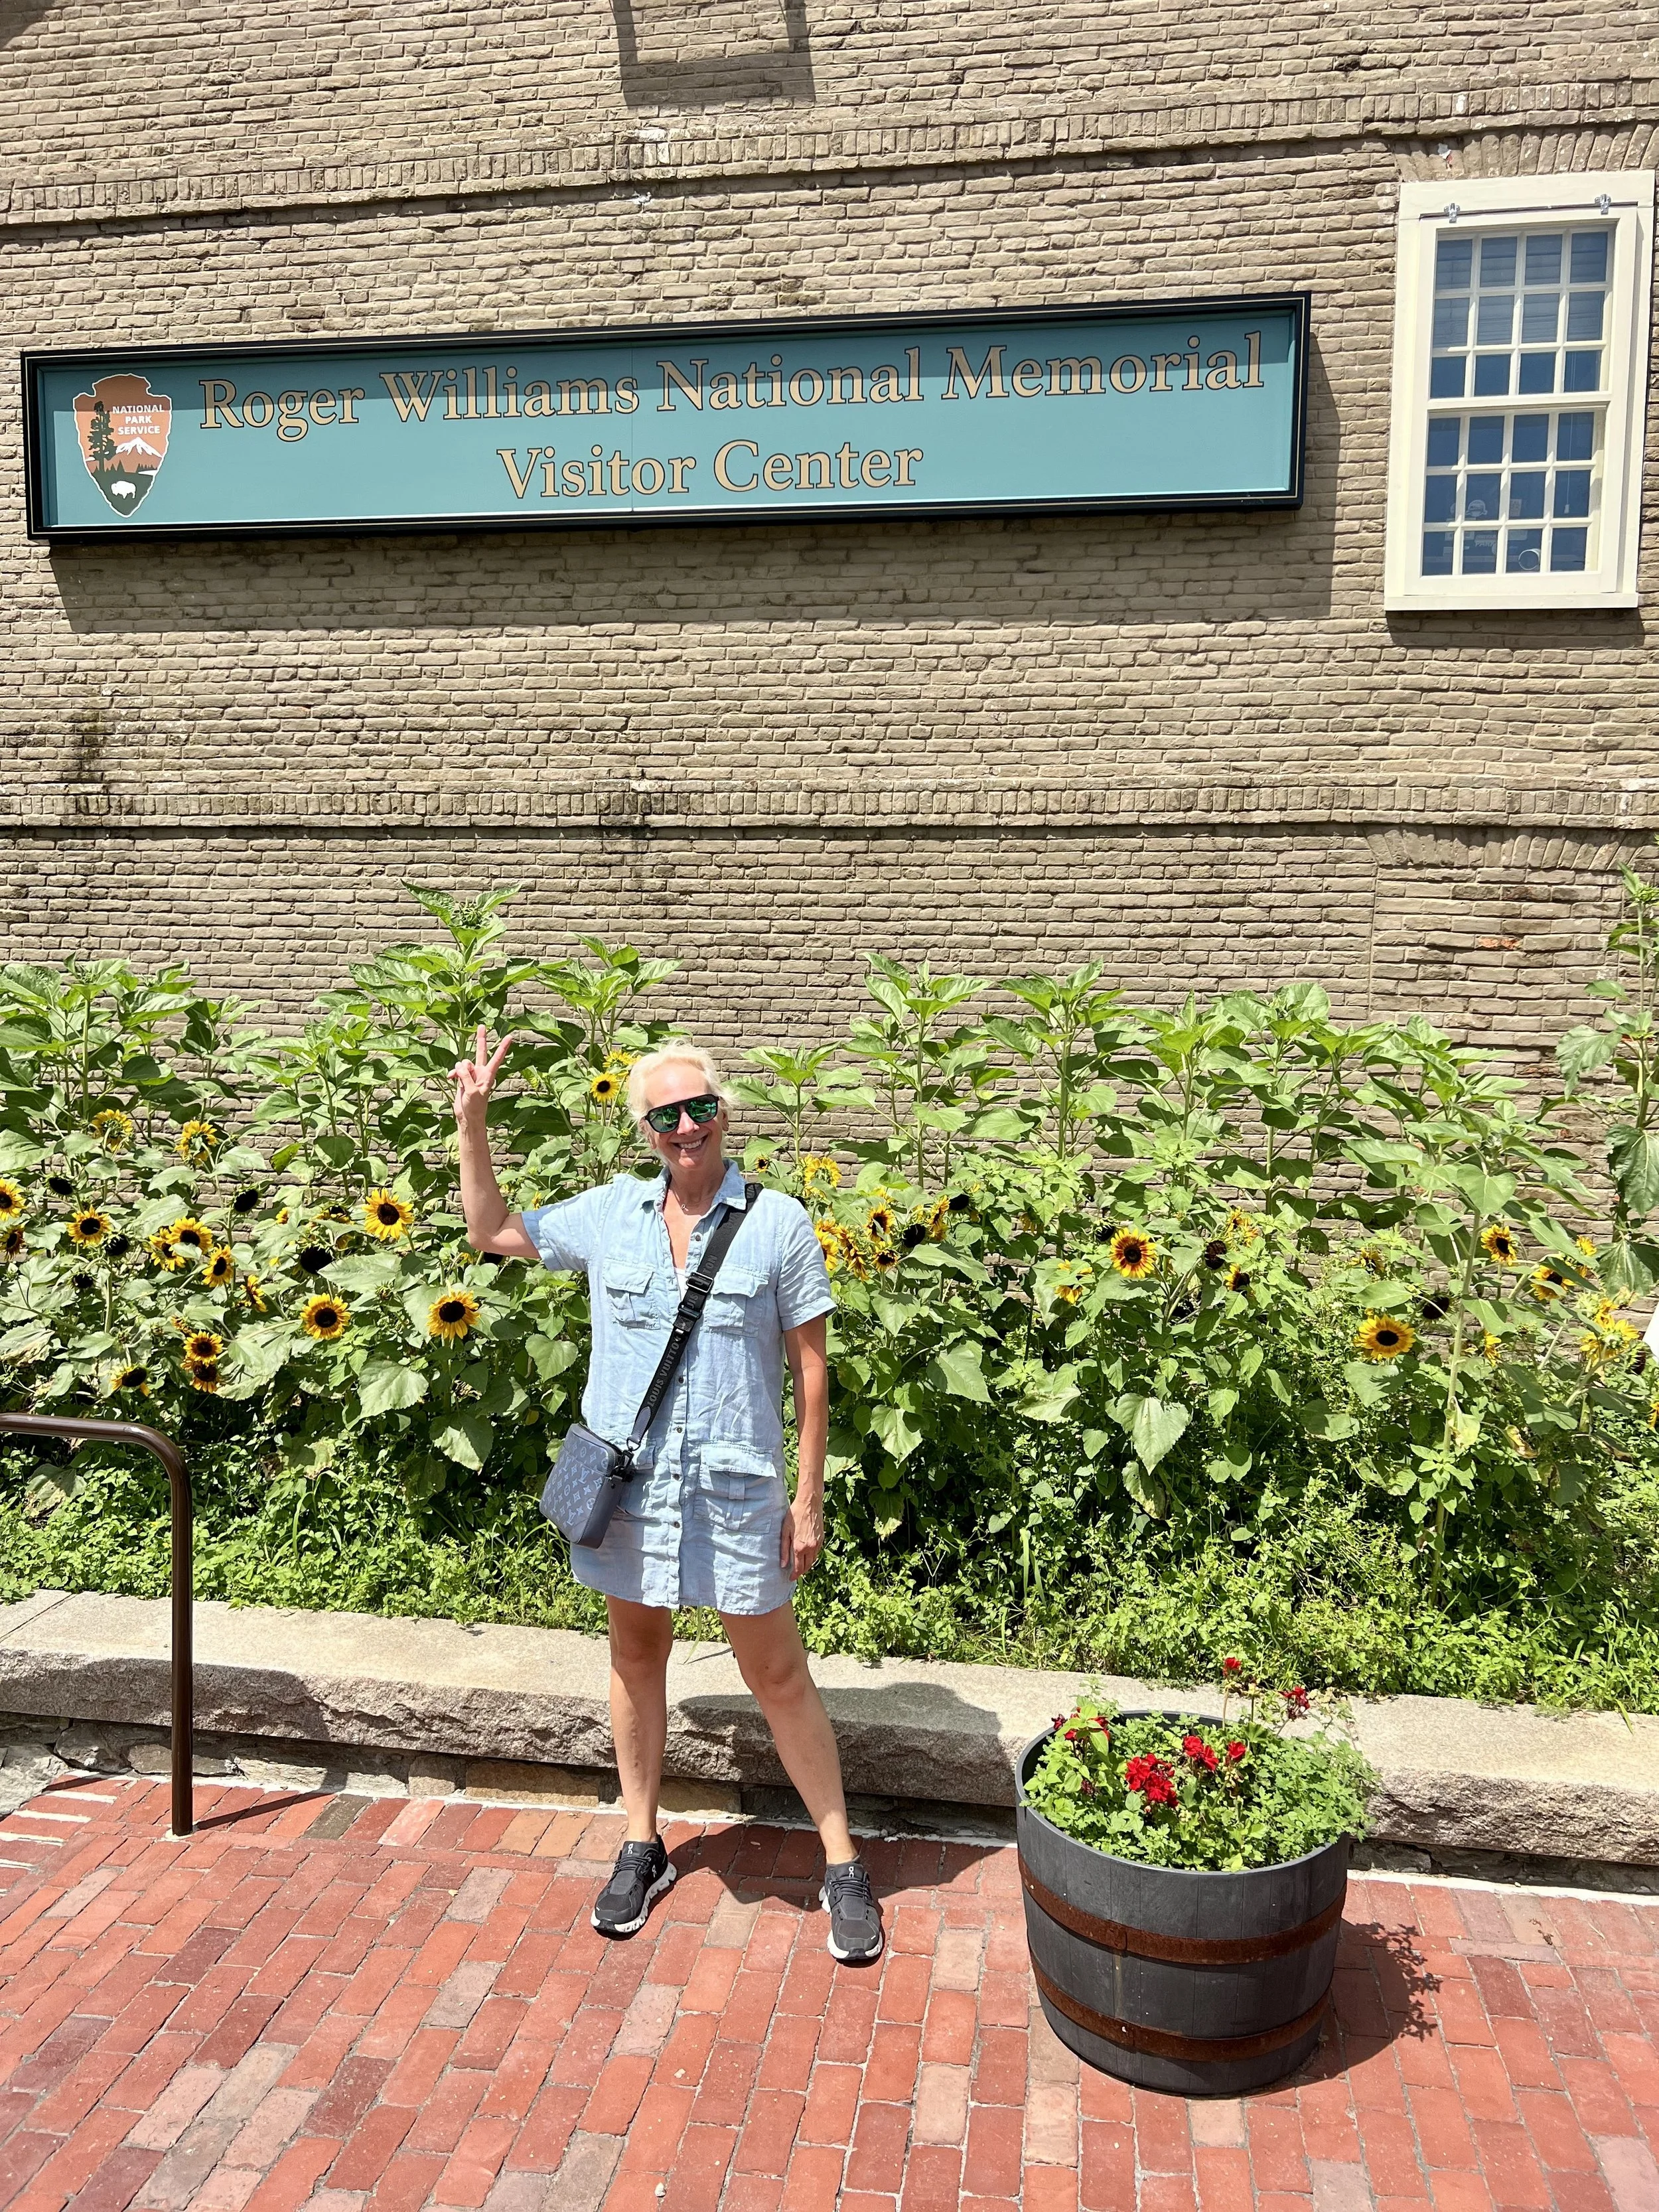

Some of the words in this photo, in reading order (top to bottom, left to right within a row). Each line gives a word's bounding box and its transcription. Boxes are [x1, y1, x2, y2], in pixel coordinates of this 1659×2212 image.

[200, 378, 366, 442] Roger
[379, 366, 640, 423] Williams
[656, 346, 924, 411] National
[940, 331, 1264, 400] Memorial
[112, 404, 165, 414] NATIONAL
[125, 415, 153, 424] PARK
[117, 425, 161, 435] SERVICE
[496, 445, 697, 499] Visitor
[713, 439, 924, 492] Center
[647, 1378, 664, 1407] LOUIS
